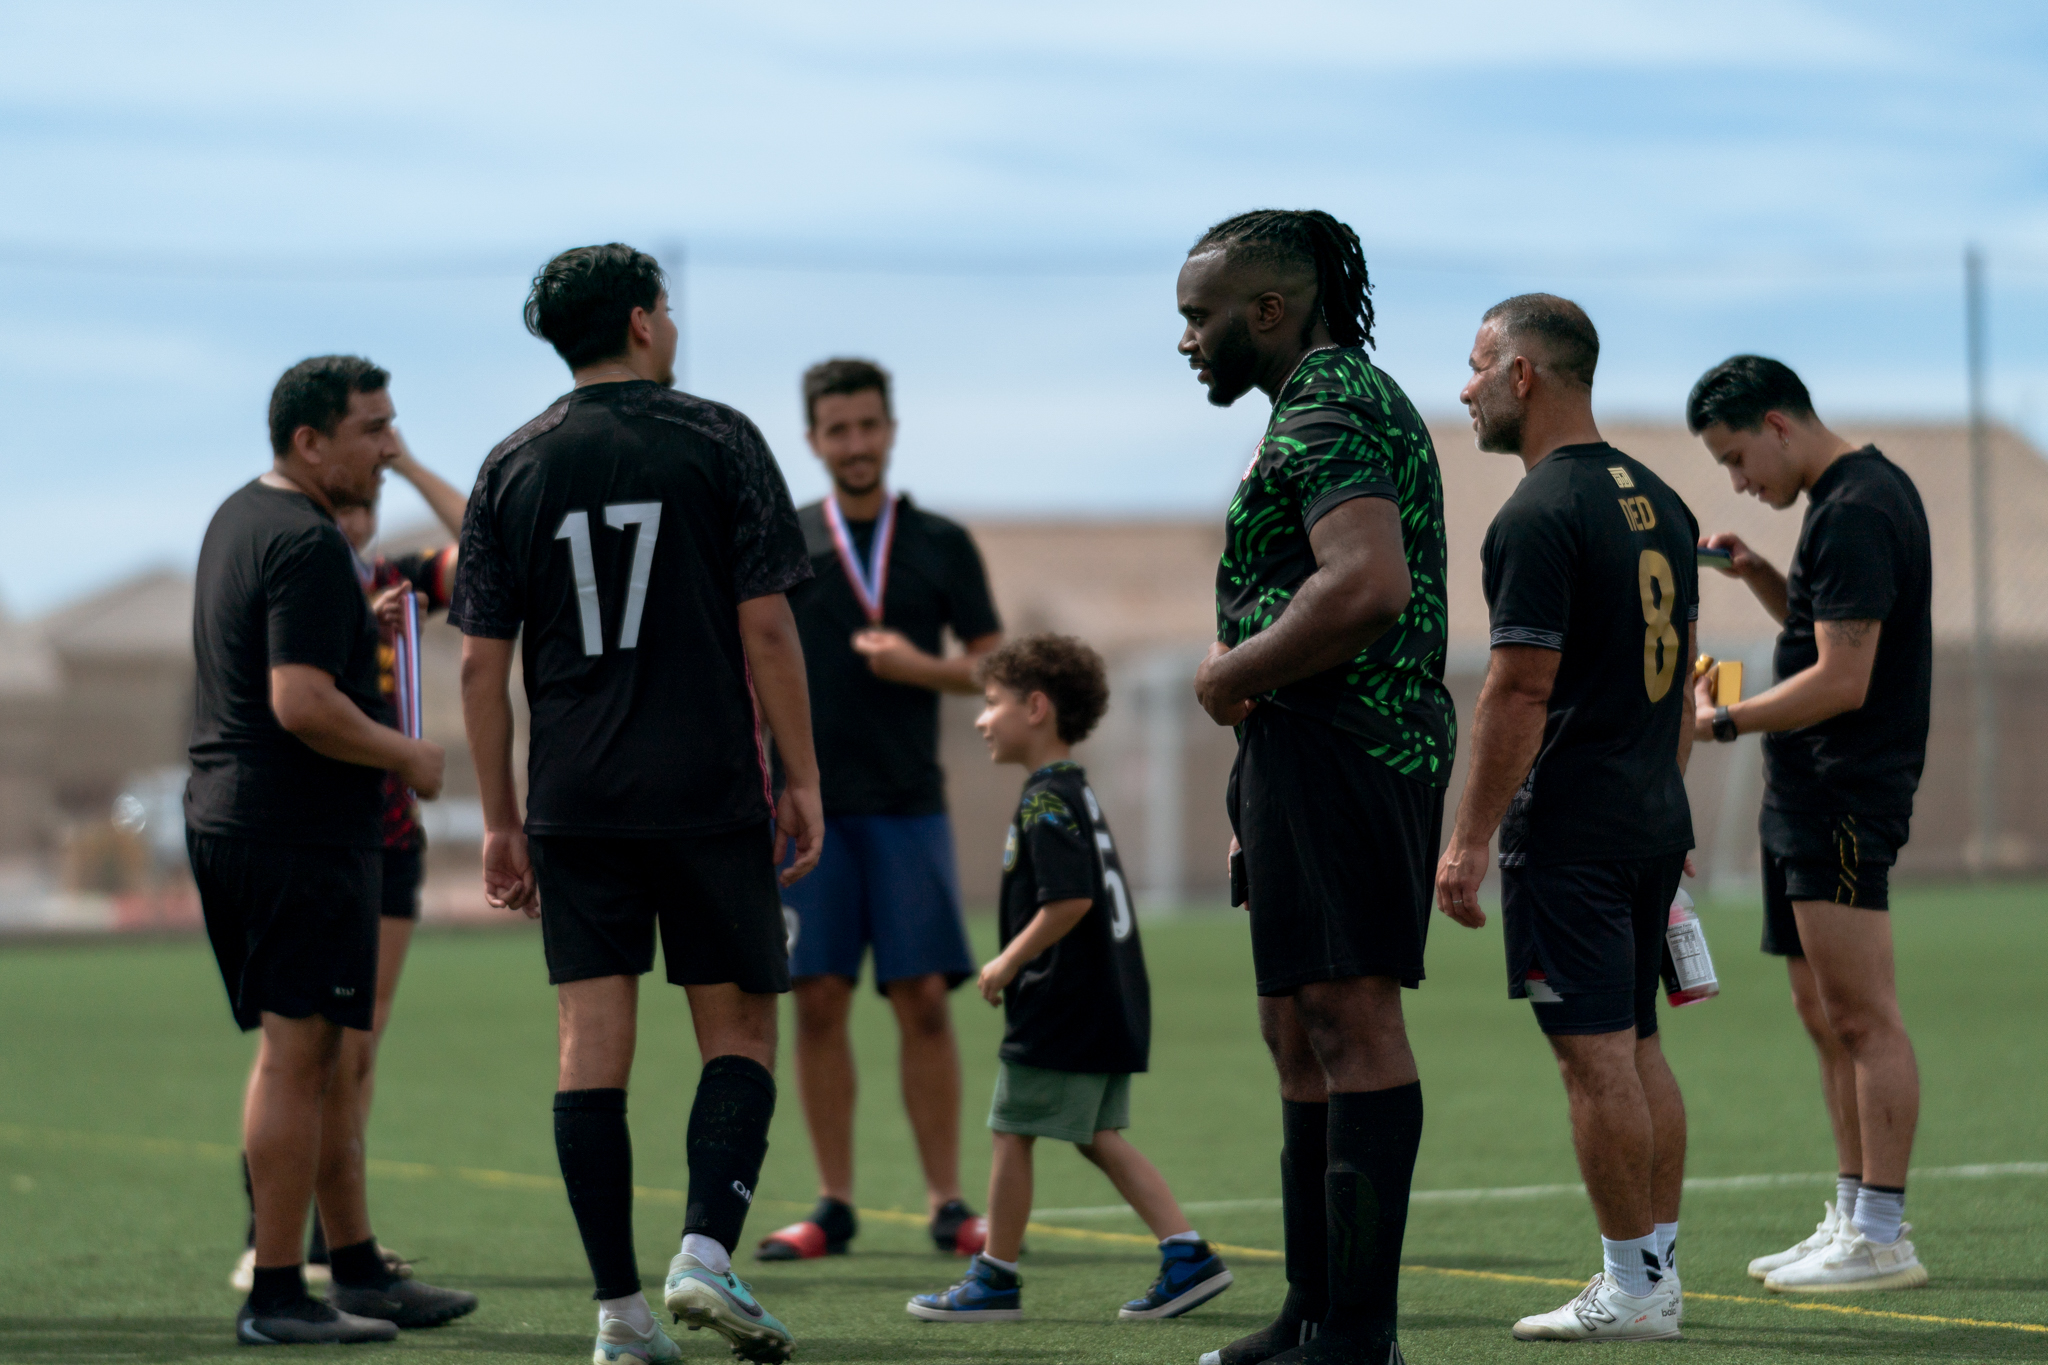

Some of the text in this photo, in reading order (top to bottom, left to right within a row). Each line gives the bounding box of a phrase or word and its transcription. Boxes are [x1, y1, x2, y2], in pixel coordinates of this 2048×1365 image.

[554, 502, 663, 656] 17
[1618, 497, 1656, 532] NED
[1638, 550, 1679, 703] 8
